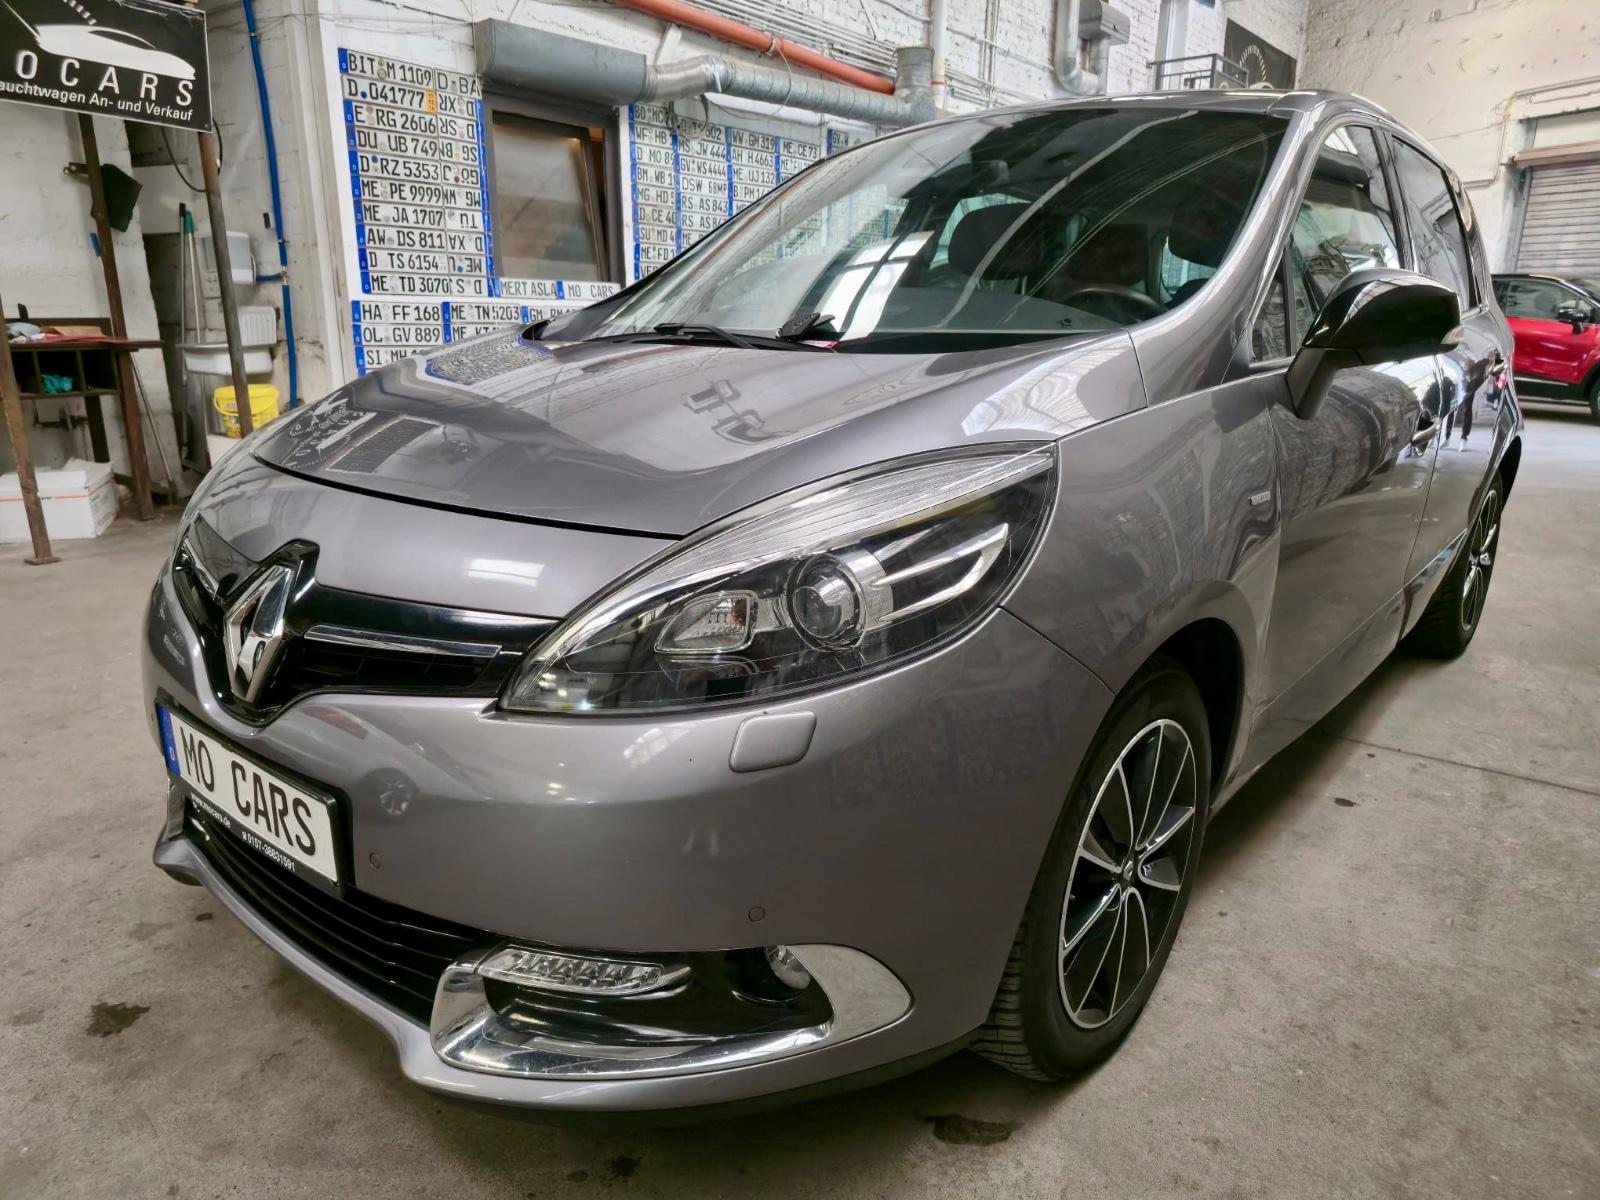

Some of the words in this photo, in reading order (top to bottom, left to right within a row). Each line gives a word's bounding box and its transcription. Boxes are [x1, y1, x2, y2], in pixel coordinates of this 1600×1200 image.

[349, 53, 375, 74] BIT
[387, 62, 396, 80] M
[399, 64, 431, 87] 1109
[347, 78, 358, 96] D
[89, 94, 113, 106] An-
[117, 100, 141, 113] und
[146, 102, 193, 121] Verkauf
[355, 105, 365, 123] E
[376, 109, 396, 128] RG
[400, 113, 436, 134] 2606
[357, 130, 377, 149] DU
[388, 134, 408, 152] UB
[411, 138, 438, 157] 749
[360, 155, 370, 172] D
[380, 158, 400, 176] RZ
[403, 161, 439, 180] 5353
[362, 179, 380, 198] ME
[390, 182, 407, 200] PE
[410, 185, 442, 204] 9999
[363, 205, 381, 222] ME
[392, 207, 409, 224] JA
[412, 209, 443, 227] 1707
[367, 228, 386, 245] AW
[397, 231, 415, 247] DS
[419, 232, 445, 249] 811
[369, 251, 377, 267] D
[388, 253, 405, 269] TS
[408, 254, 439, 271] 6154
[371, 275, 389, 292] ME
[399, 276, 415, 292] TD
[419, 277, 450, 293] 3070
[568, 284, 581, 298] MO
[590, 285, 613, 299] CARS
[362, 304, 382, 321] HA
[392, 305, 411, 321] FF
[414, 305, 440, 321] 168
[451, 305, 465, 320] ME
[475, 305, 489, 320] TN
[363, 327, 383, 343] OL
[392, 327, 411, 343] GV
[414, 327, 440, 343] 889
[180, 726, 215, 792] MO
[230, 760, 316, 856] CARS
